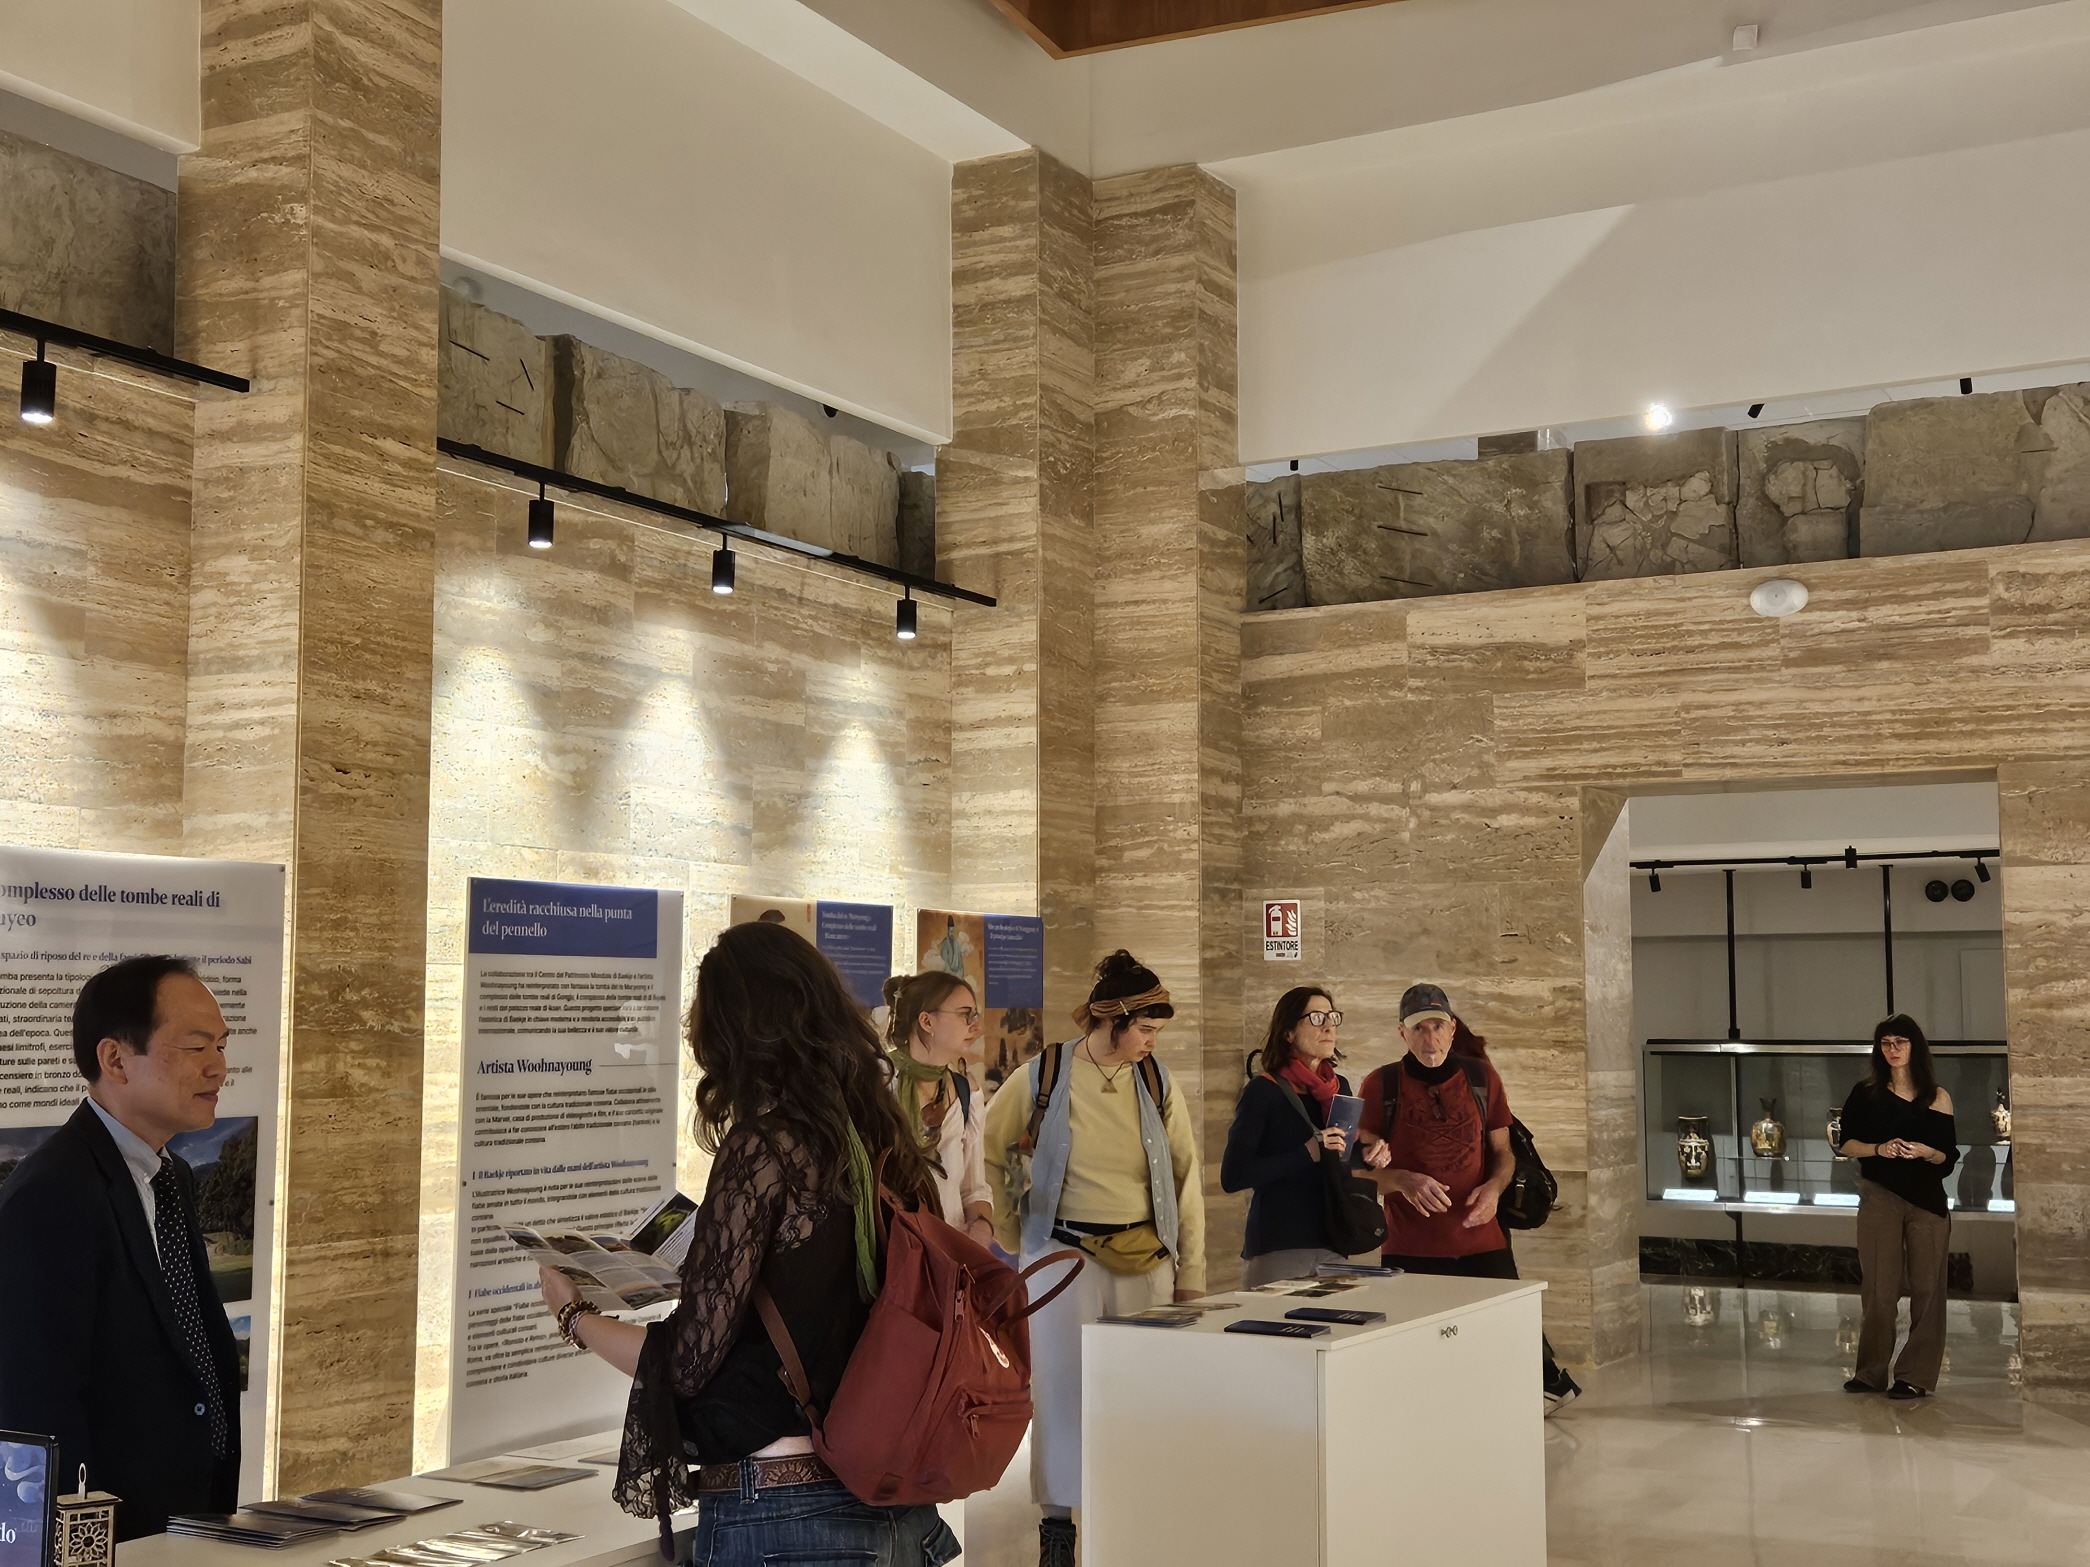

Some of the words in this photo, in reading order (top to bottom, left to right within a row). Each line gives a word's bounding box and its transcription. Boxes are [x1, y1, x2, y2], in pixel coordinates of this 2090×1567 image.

[79, 885, 116, 902] delle
[121, 888, 168, 905] tombe
[171, 890, 202, 907] reali
[206, 891, 220, 907] di
[483, 898, 526, 914] L'eredità
[529, 902, 577, 916] racchiusa
[579, 904, 602, 918] nella
[604, 908, 632, 922] punta
[482, 921, 498, 935] del
[501, 923, 548, 939] pennello
[1265, 940, 1298, 951] ESTINTORE
[1, 951, 28, 962] spazio
[30, 951, 38, 960] di
[41, 951, 67, 963] riposo
[68, 952, 81, 961] del
[208, 955, 235, 966] periodo
[477, 1059, 514, 1074] Artista
[517, 1058, 592, 1076] Woohnayoung
